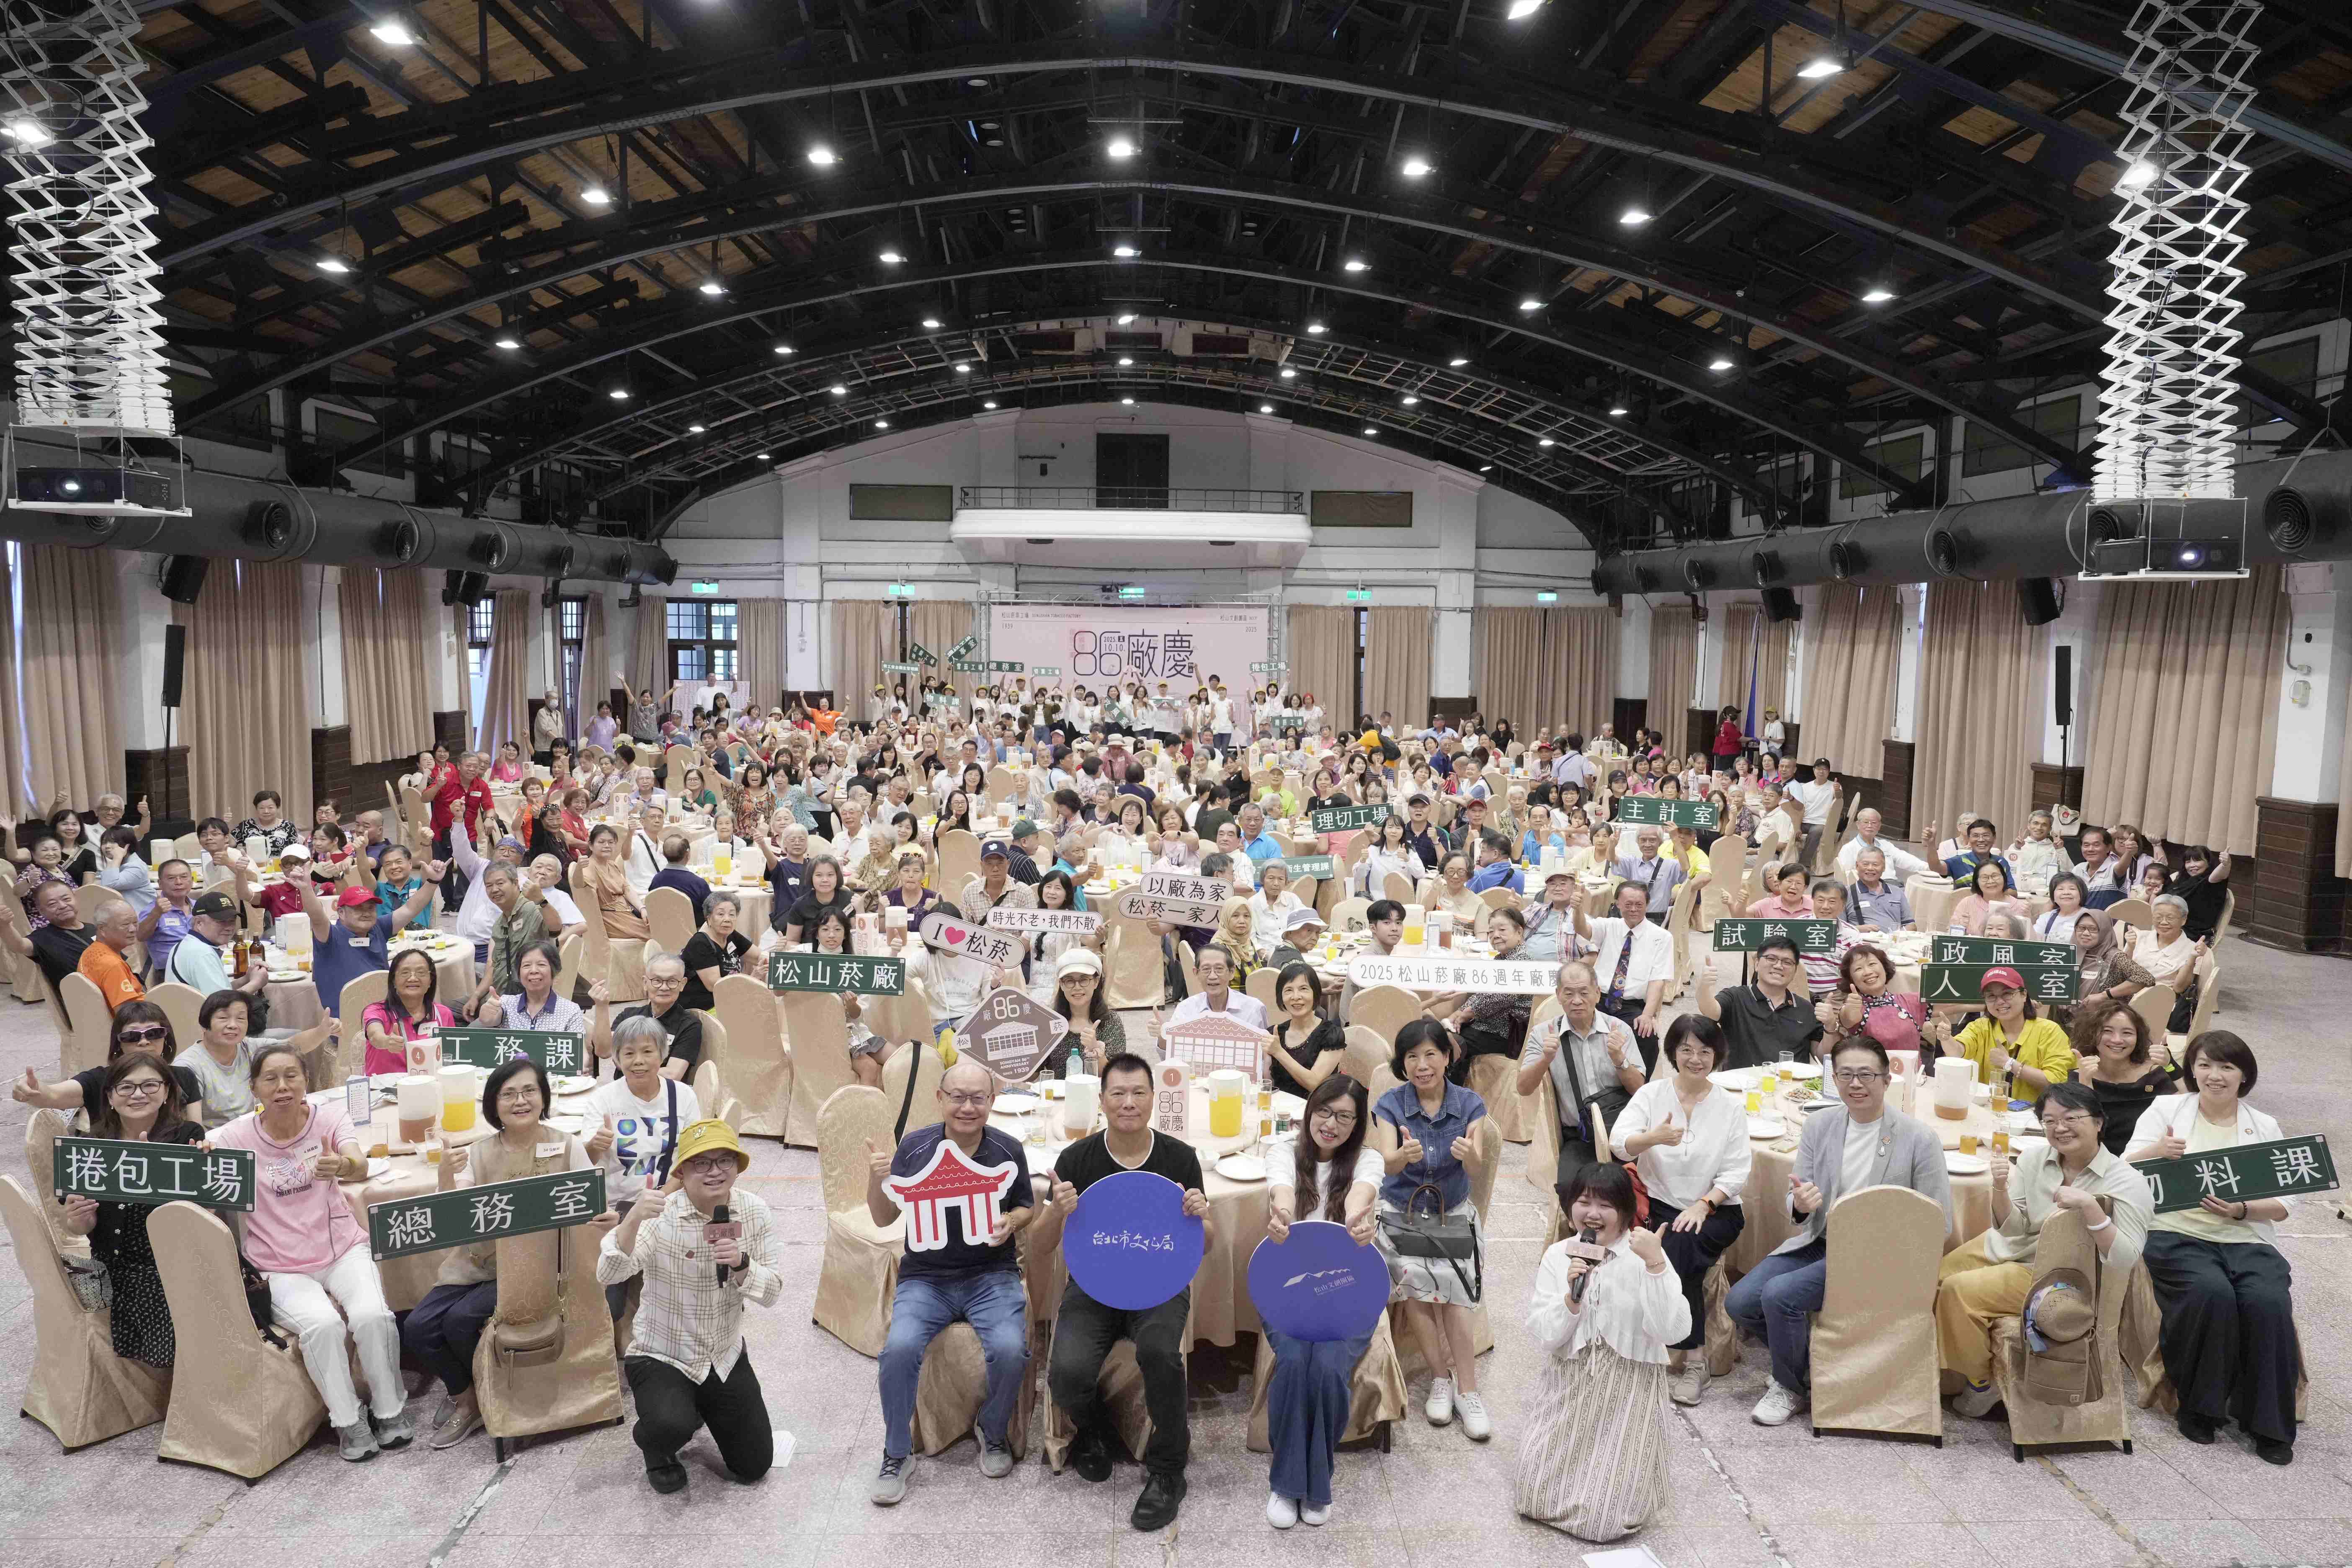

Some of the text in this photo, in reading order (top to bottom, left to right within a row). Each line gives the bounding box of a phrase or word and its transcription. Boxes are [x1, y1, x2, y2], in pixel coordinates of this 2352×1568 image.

[989, 662, 1022, 671] 總務室
[926, 694, 959, 705] 物料課
[1317, 806, 1389, 830] 理切工場
[1625, 800, 1712, 825] 主計室
[1147, 877, 1226, 902] 以廠為家
[965, 932, 1013, 962] 松菸
[775, 958, 898, 990] 松山菸廠
[1930, 970, 2070, 999] 人室
[1169, 1073, 1173, 1083] 1
[1894, 1062, 1898, 1070] 2
[1159, 1091, 1183, 1113] 86
[1158, 1114, 1183, 1132] 廠慶
[66, 1146, 243, 1203] 捲包工場
[387, 1180, 593, 1249] 總務室
[1093, 1230, 1174, 1251] 台北市文化局
